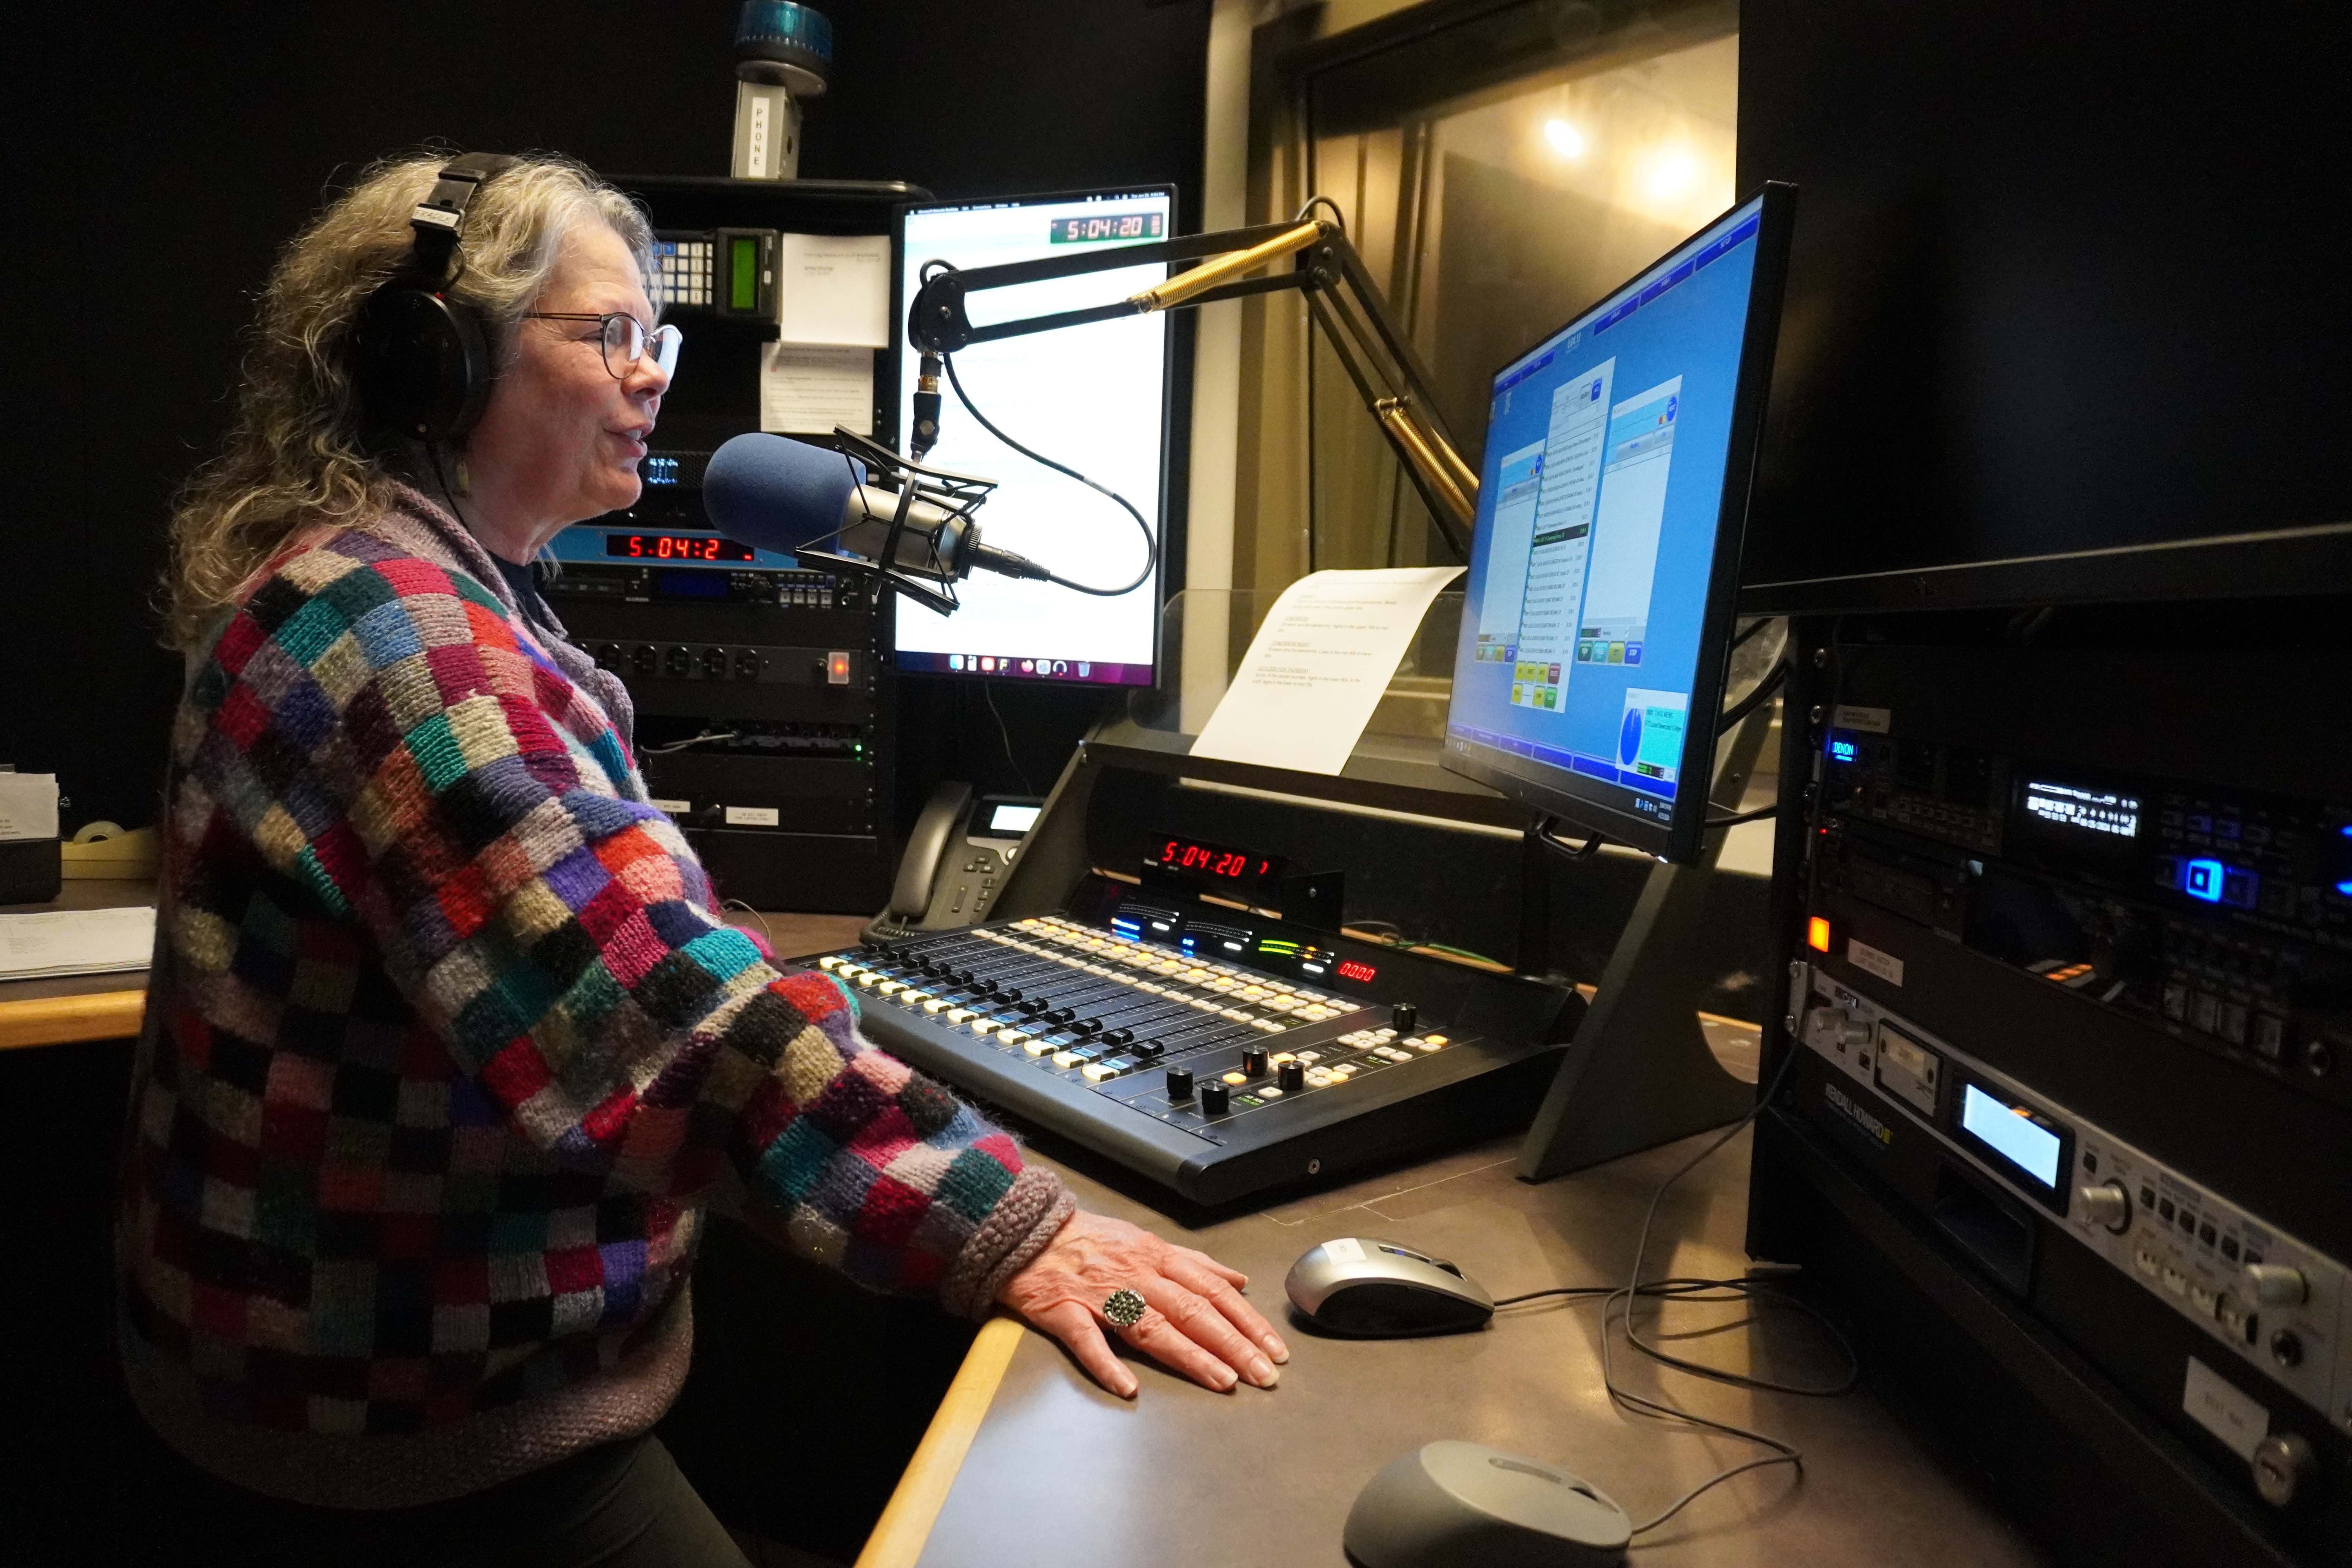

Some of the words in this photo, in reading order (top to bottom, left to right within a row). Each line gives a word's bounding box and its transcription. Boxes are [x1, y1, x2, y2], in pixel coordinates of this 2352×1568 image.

[754, 108, 762, 165] PHONE
[415, 209, 452, 224] FRAGILE
[1067, 216, 1143, 240] 5:04:20
[1834, 742, 1854, 755] DENON
[1161, 841, 1246, 877] 5:04:20
[1825, 1082, 1853, 1117] KENDALL
[1853, 1103, 1884, 1139] HOWARD
